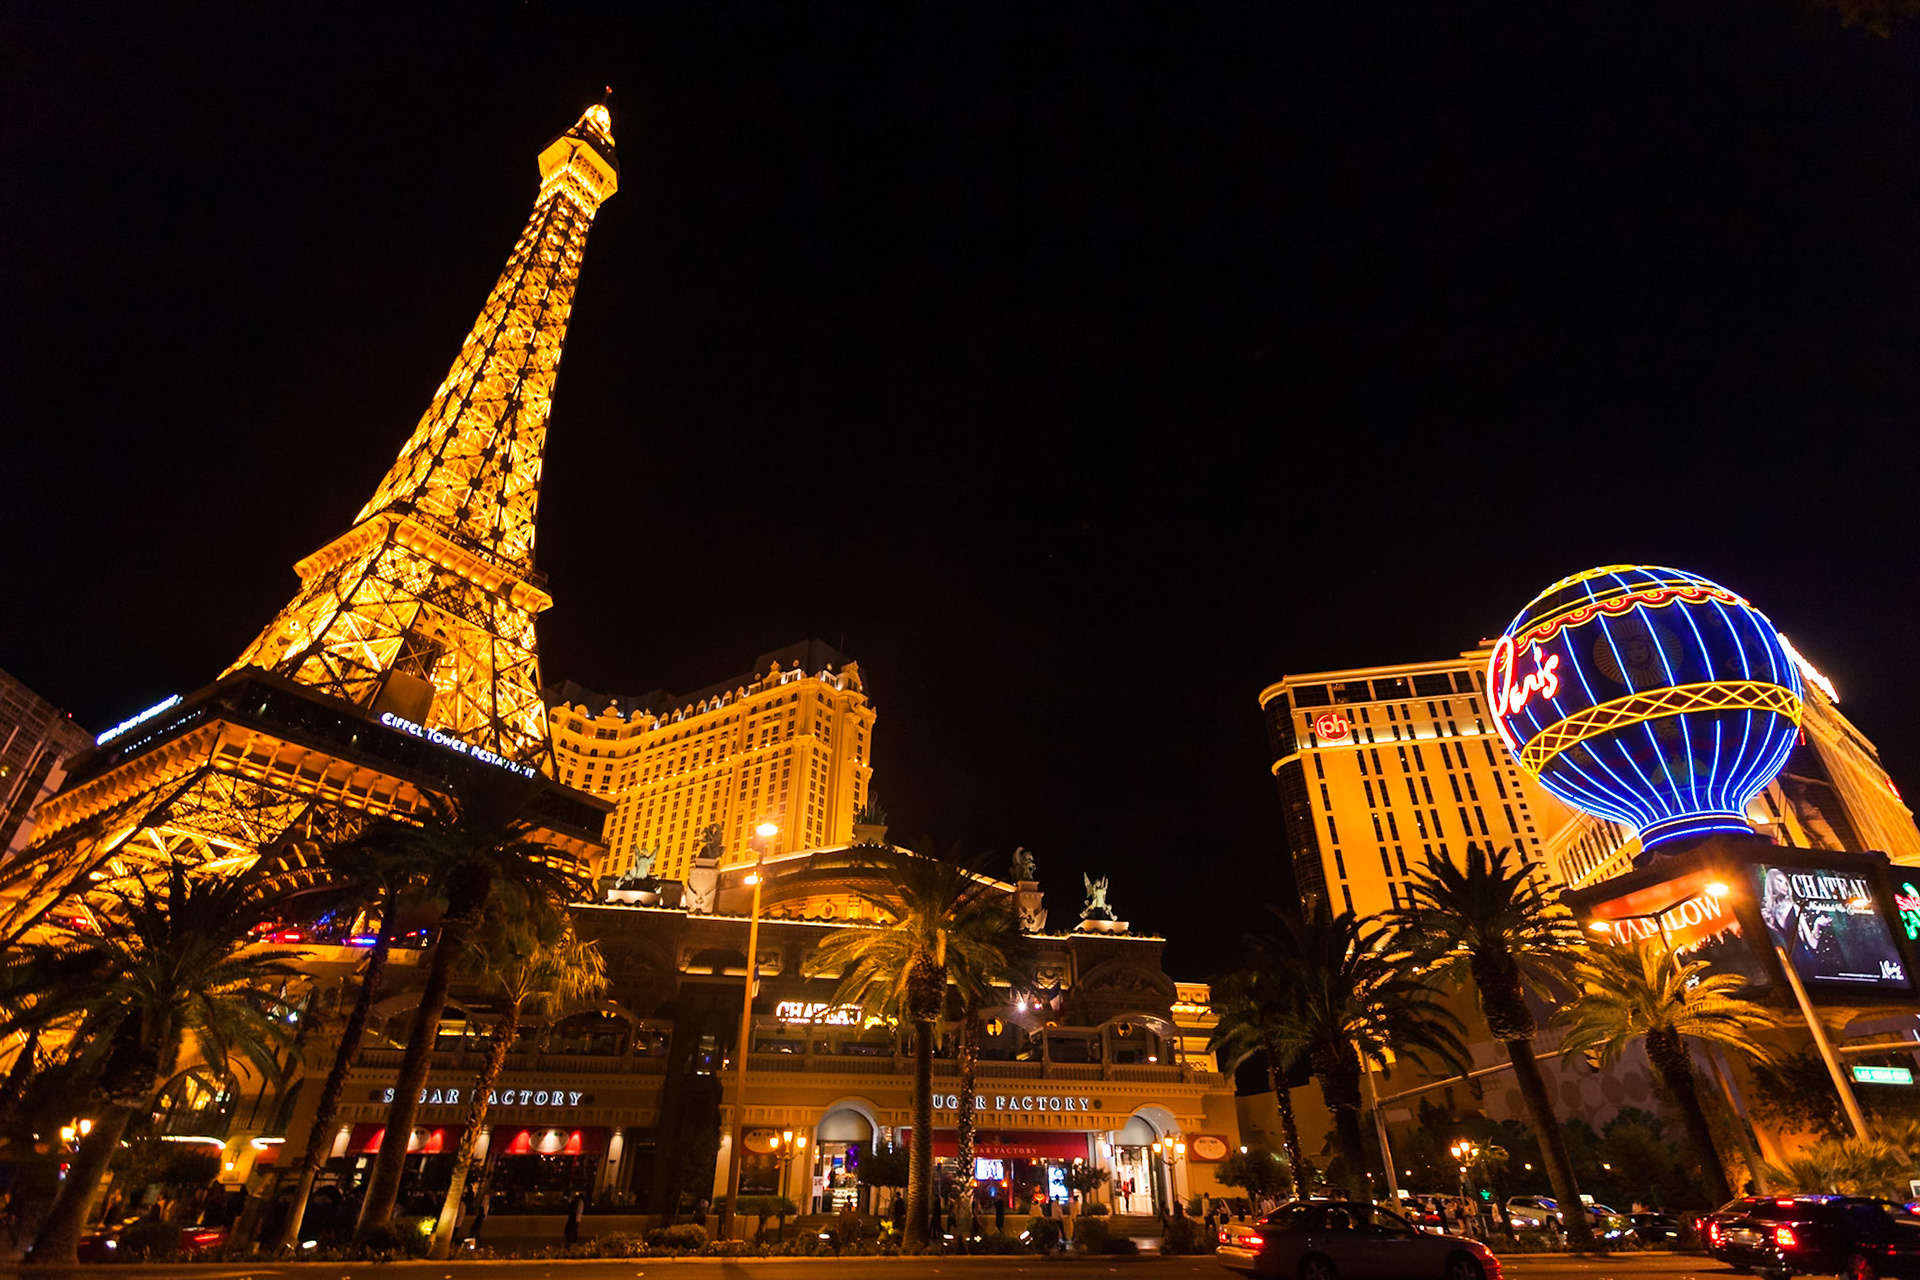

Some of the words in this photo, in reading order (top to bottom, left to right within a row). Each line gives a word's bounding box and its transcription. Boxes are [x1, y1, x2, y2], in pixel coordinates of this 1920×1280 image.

[1486, 634, 1560, 752] Paris
[381, 712, 424, 738] EIFFEL
[426, 727, 468, 753] TOWER
[1320, 713, 1349, 736] ph
[1791, 873, 1873, 904] CHATEAU
[1608, 895, 1722, 946] MANILOW
[382, 1088, 460, 1105] SGAR
[469, 1089, 583, 1106] ACTORY
[932, 1094, 987, 1110] UGR
[995, 1095, 1090, 1111] FACTORY
[994, 1147, 1037, 1155] FACTORY
